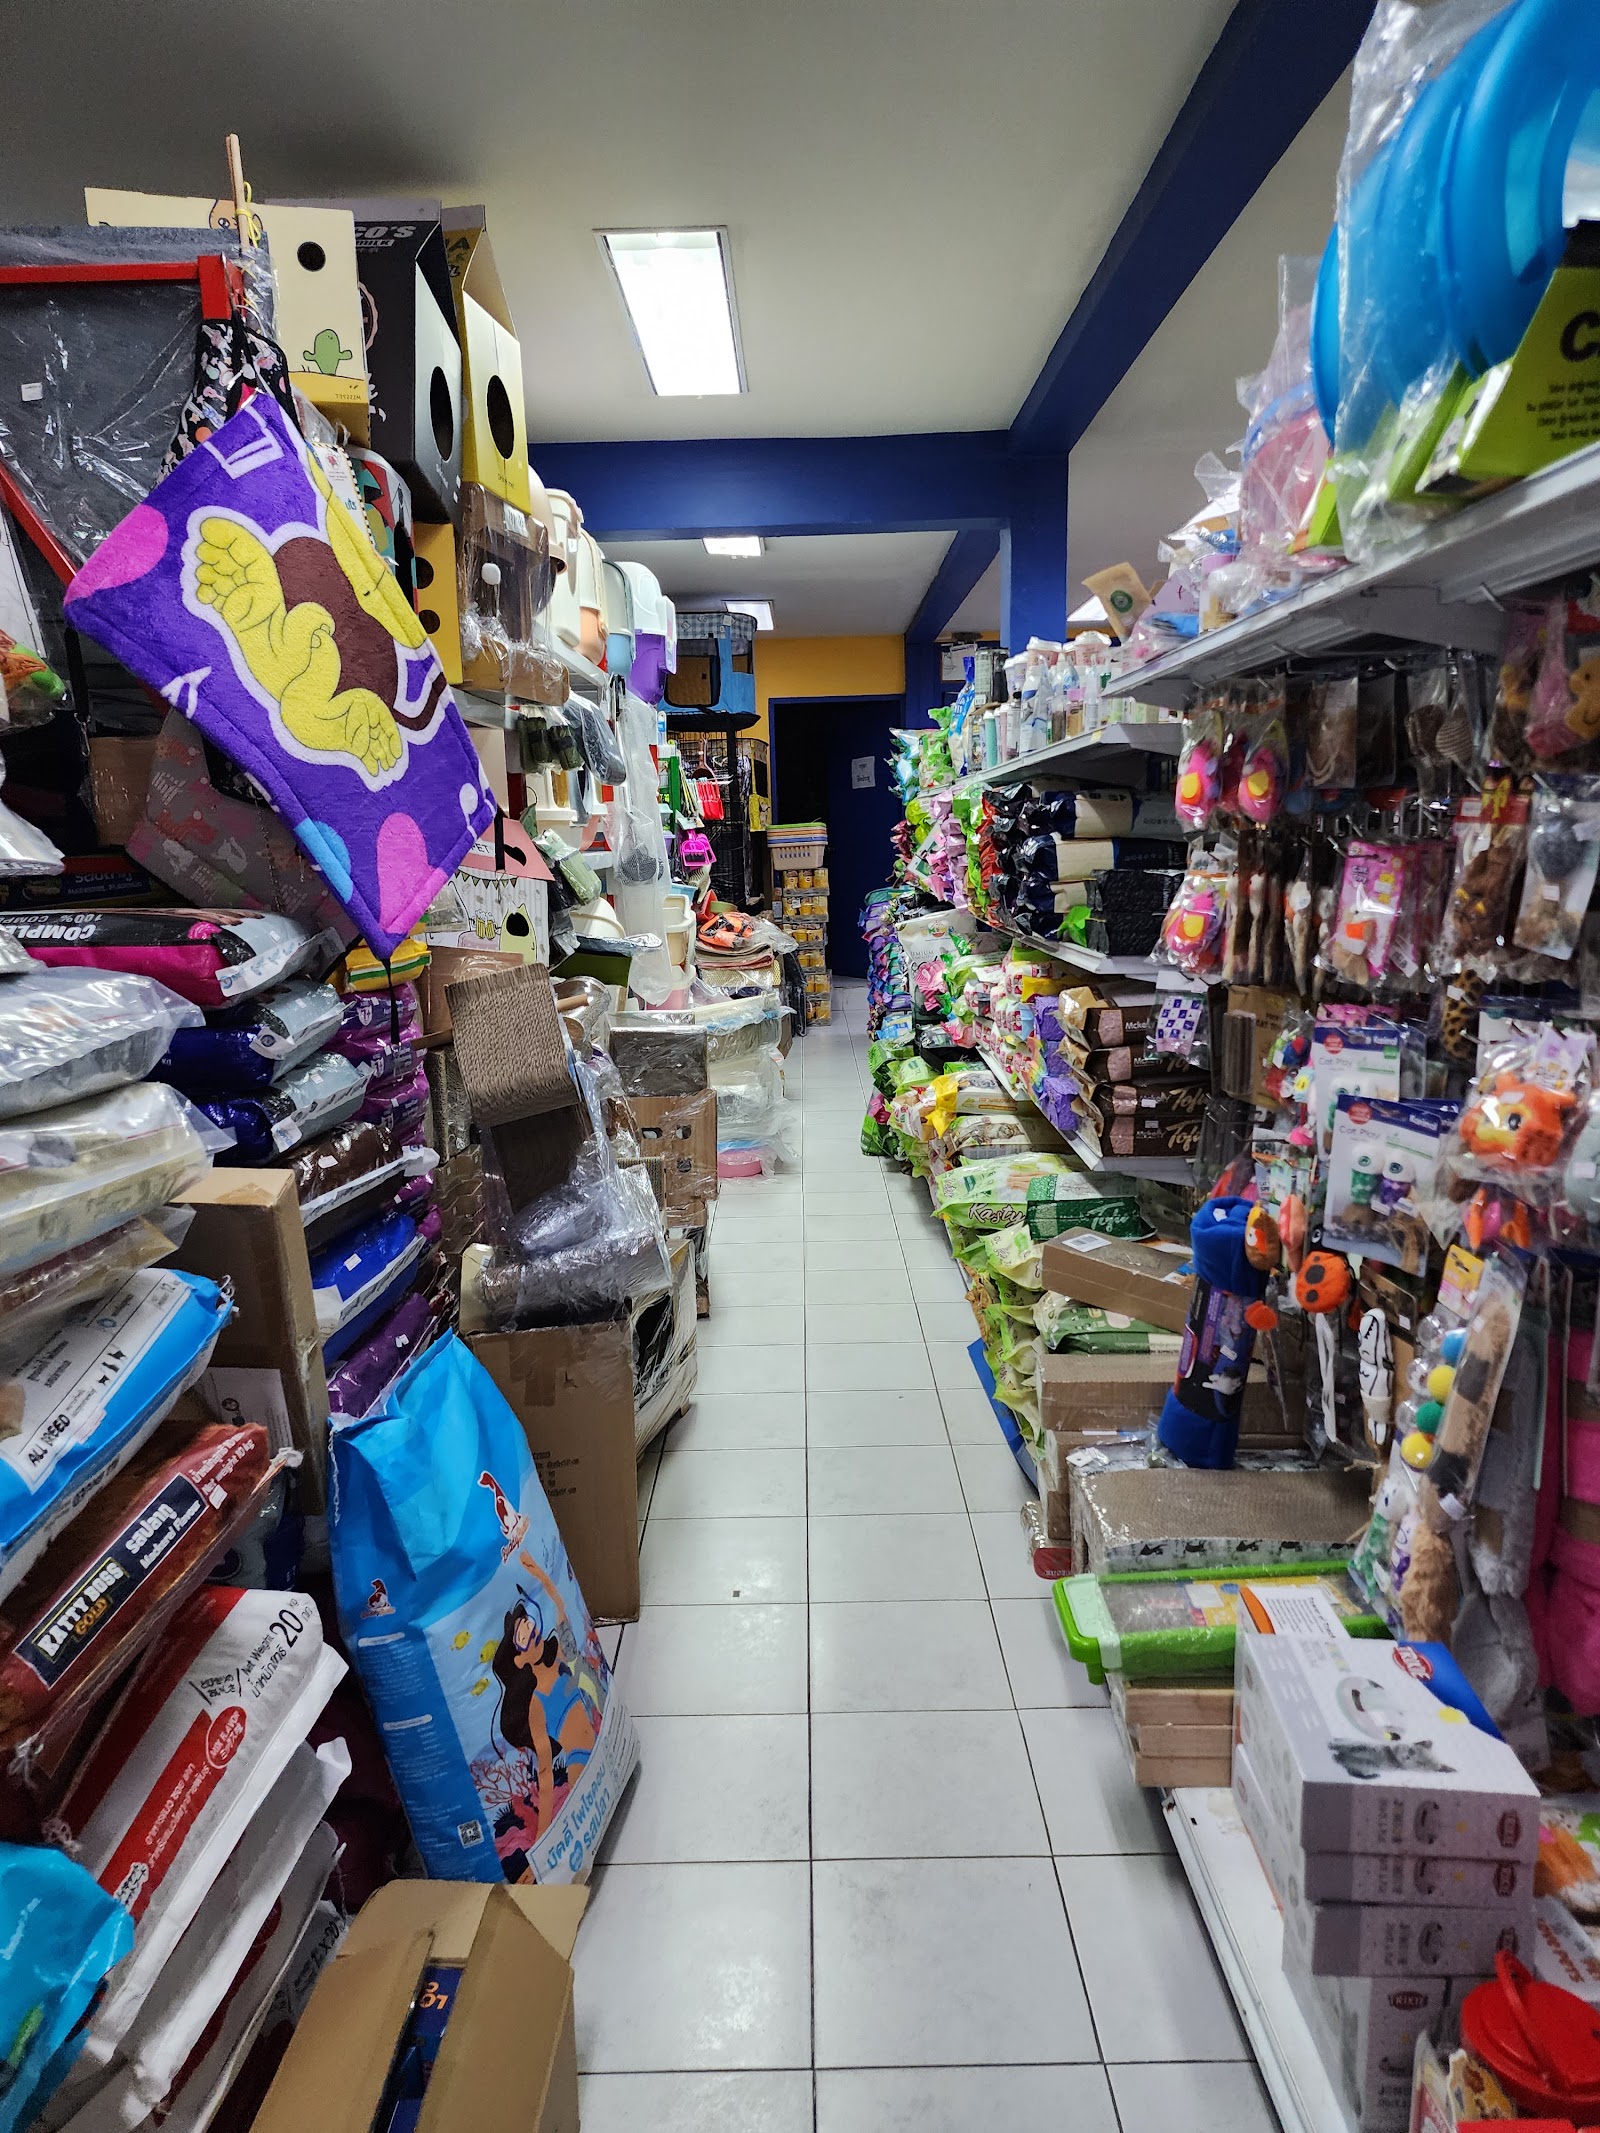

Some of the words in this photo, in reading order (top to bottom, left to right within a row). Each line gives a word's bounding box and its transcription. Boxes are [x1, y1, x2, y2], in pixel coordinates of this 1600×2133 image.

[61, 914, 104, 924] 100%
[969, 1202, 1026, 1228] Kasty
[202, 1478, 217, 1496] Net
[215, 1454, 239, 1482] weight
[83, 1561, 125, 1602] BOSS
[240, 1658, 257, 1676] Net
[249, 1633, 274, 1666] Weight
[269, 1608, 304, 1649] 20
[1392, 1645, 1433, 1681] TRIXIE
